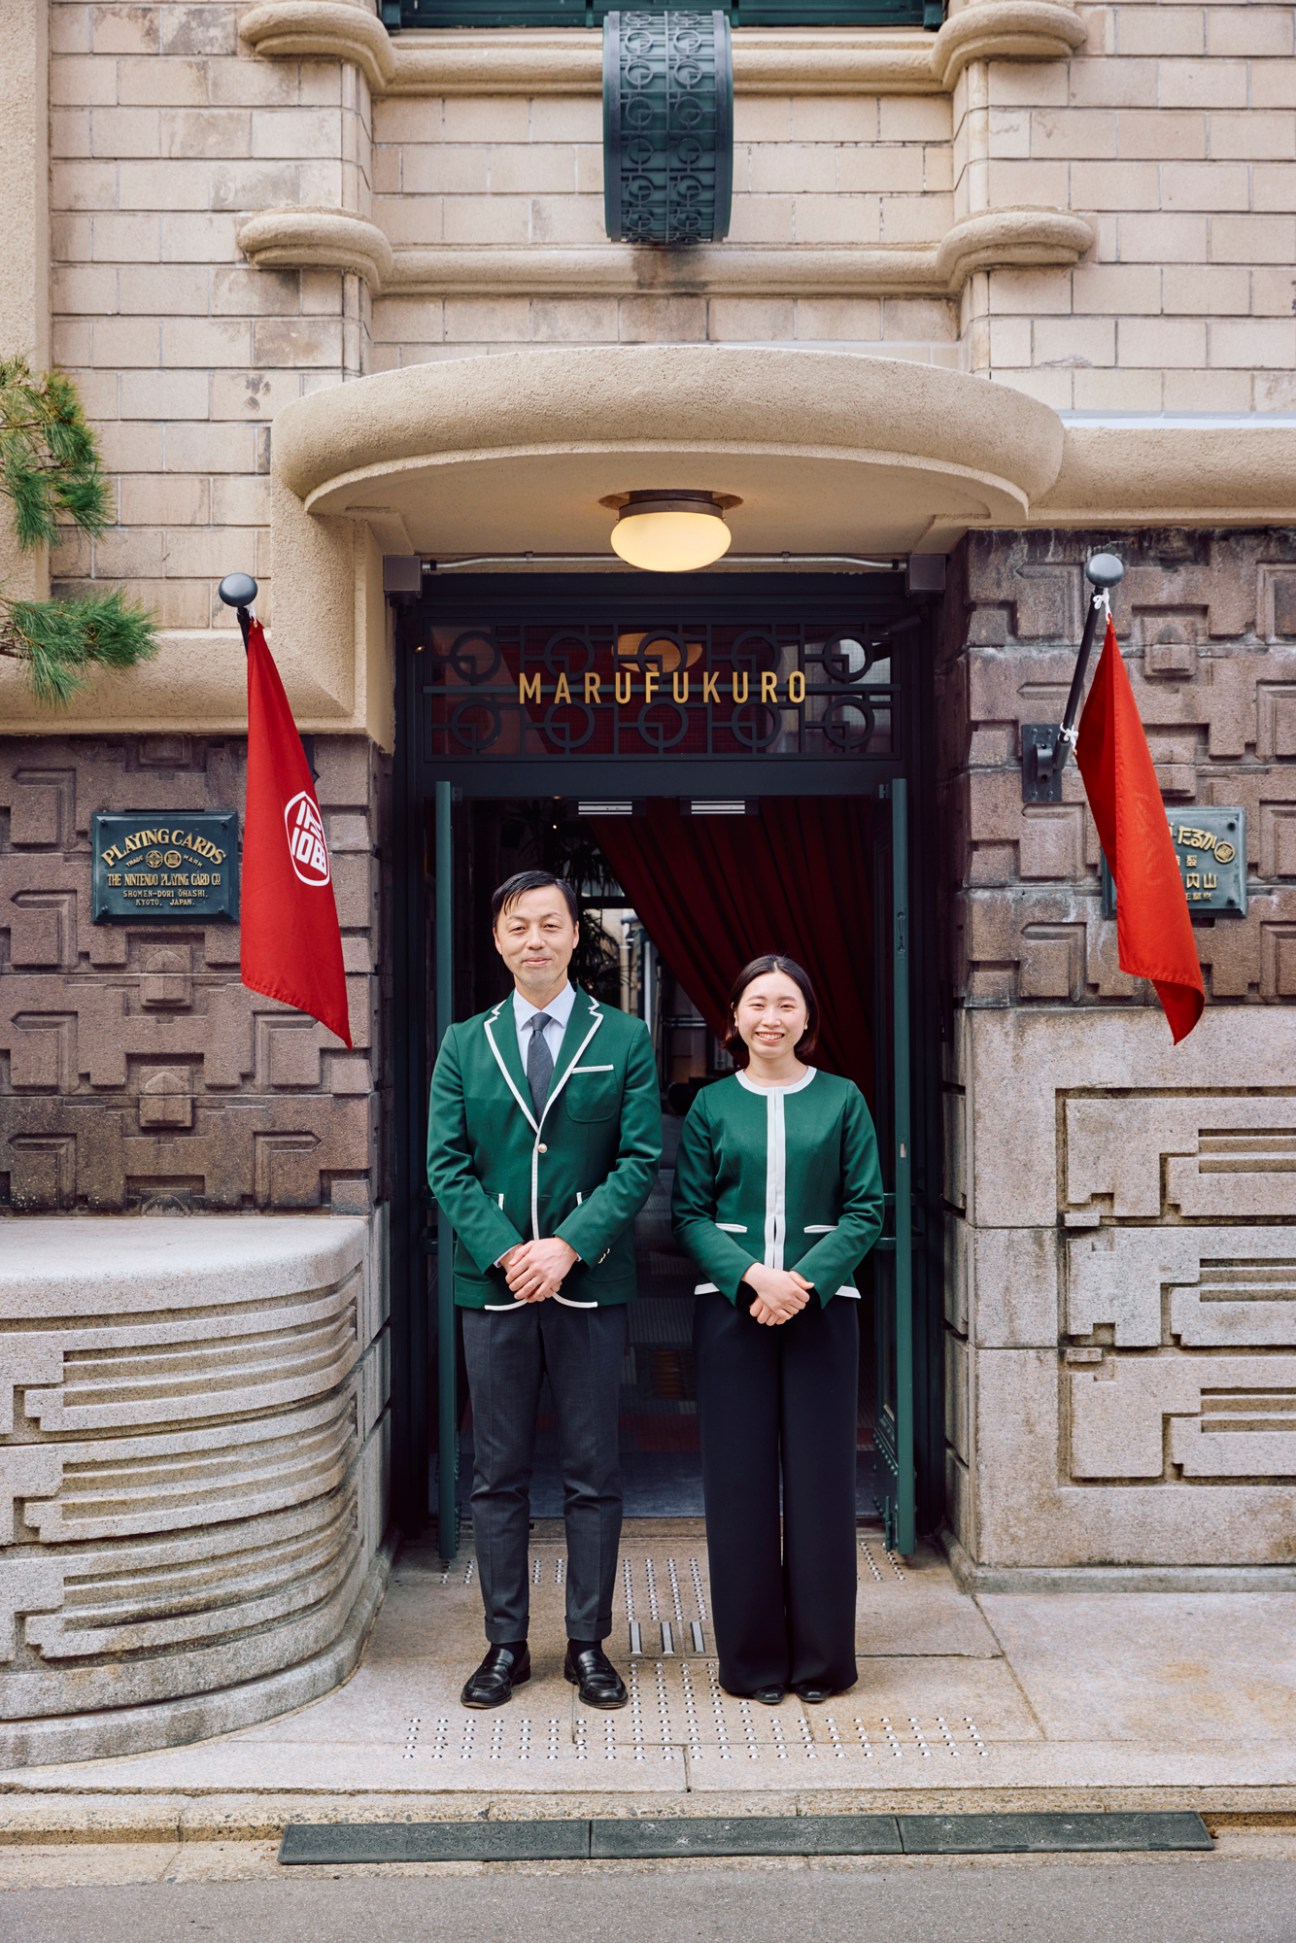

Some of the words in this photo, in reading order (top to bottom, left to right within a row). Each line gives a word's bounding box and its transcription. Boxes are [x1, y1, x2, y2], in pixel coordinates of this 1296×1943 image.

[518, 670, 807, 705] MARUFUKURO
[101, 828, 170, 867] PLAYING
[171, 829, 227, 865] CARDS
[125, 855, 144, 867] TRADE
[183, 854, 203, 867] MARK
[107, 873, 122, 886] THE
[124, 873, 159, 886] NINTENDO
[160, 873, 190, 886] PLAYING
[191, 873, 210, 886] CARD
[122, 890, 175, 898] SHOMEN-DORI
